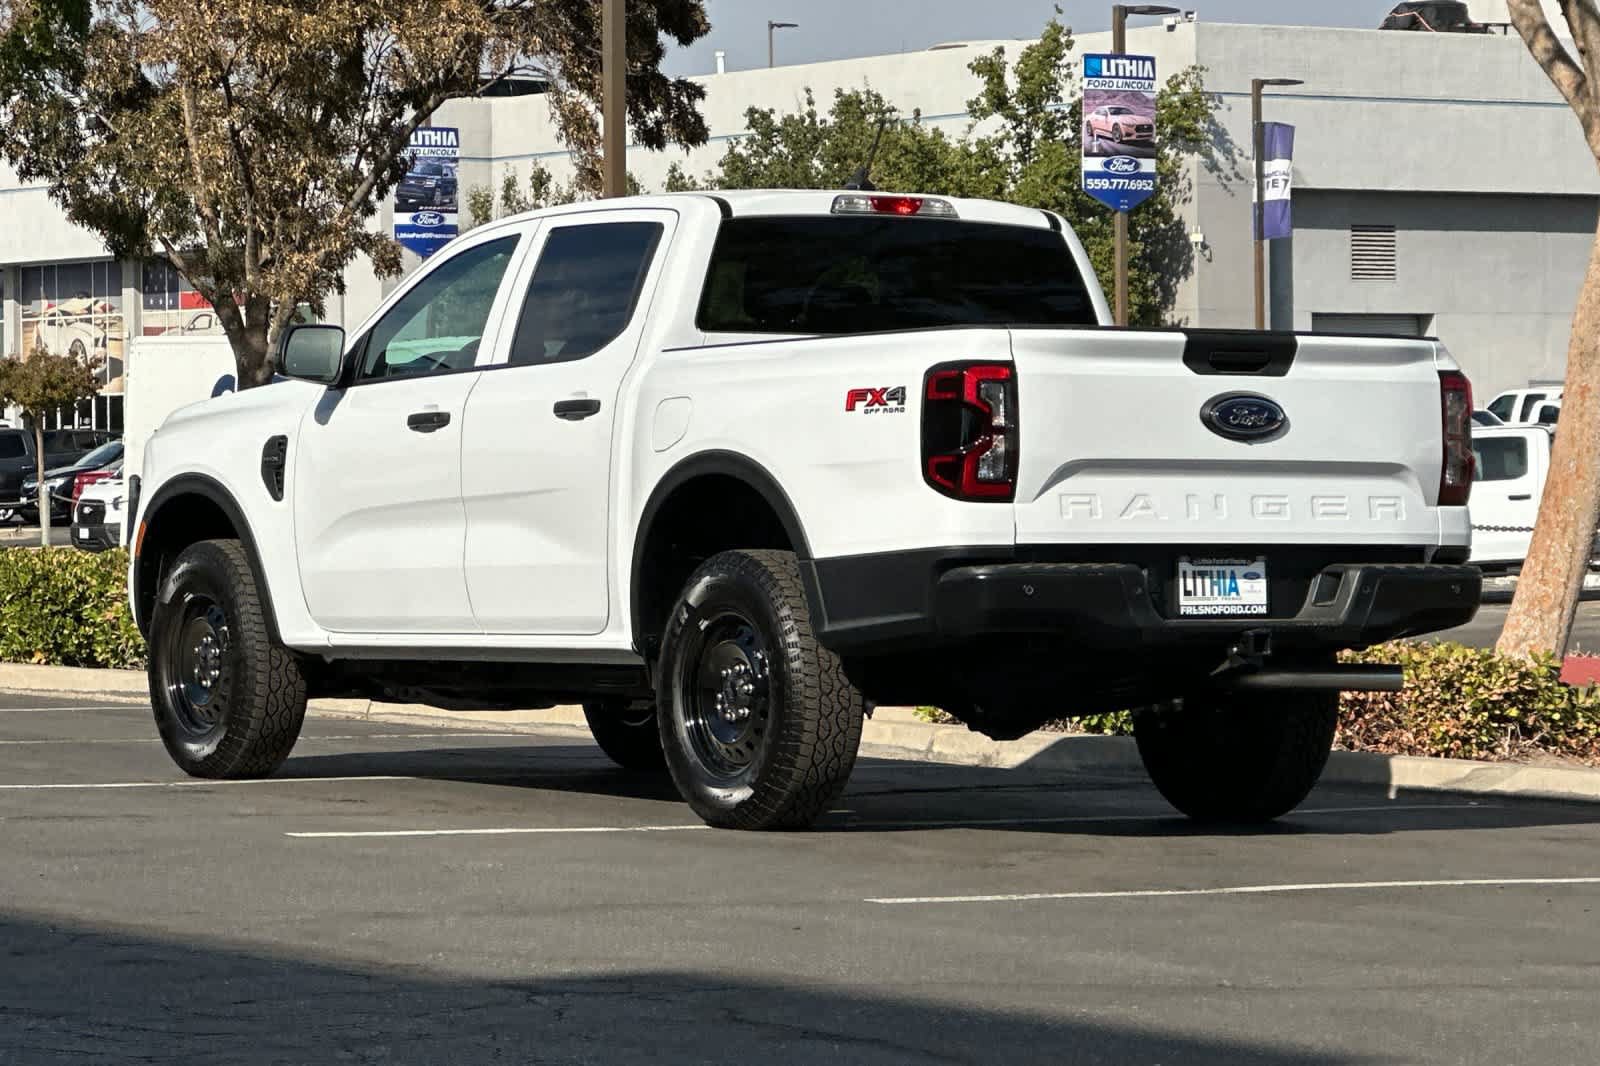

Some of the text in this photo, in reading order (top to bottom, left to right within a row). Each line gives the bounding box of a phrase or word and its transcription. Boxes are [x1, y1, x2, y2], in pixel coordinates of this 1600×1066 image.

[1101, 58, 1154, 79] LITHIA
[1086, 79, 1154, 90] FORD LINCOLN
[410, 130, 457, 146] LITHIA
[400, 148, 457, 156] ORD LINCOLN
[1109, 158, 1136, 172] Ford
[1086, 179, 1154, 190] 559.777.6952
[417, 213, 440, 225] Ford
[845, 386, 906, 411] FX4
[1059, 493, 1408, 520] RANGER
[1182, 570, 1240, 596] LITHIA
[1180, 605, 1267, 615] FRESNOFORD.COM
